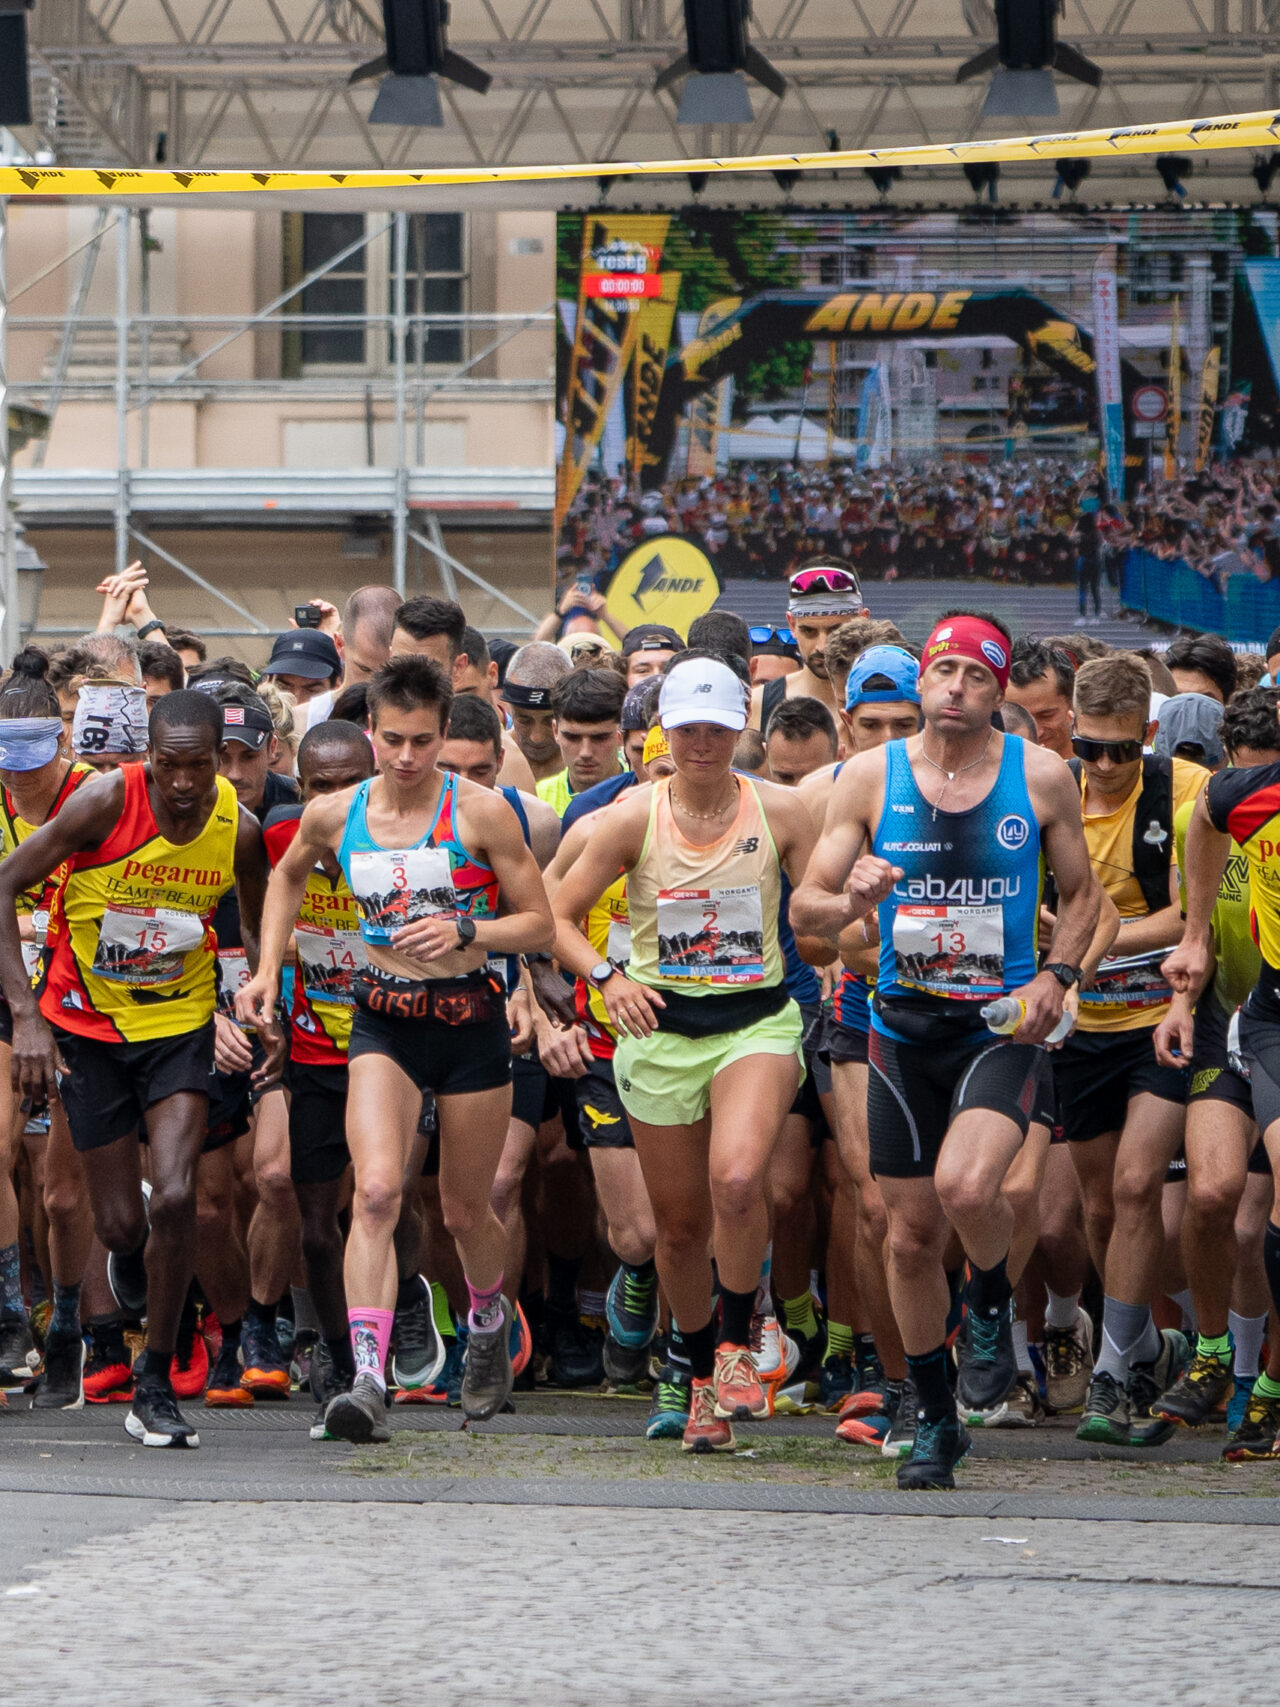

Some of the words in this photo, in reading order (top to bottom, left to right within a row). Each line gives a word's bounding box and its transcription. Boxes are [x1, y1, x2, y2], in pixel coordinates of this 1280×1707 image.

[1202, 121, 1240, 131] ANDE
[597, 255, 646, 274] reseg
[804, 290, 972, 332] ANDE
[652, 577, 706, 593] ANDE
[123, 858, 222, 888] pegarun
[392, 867, 408, 889] 3
[107, 875, 150, 898] TEAM
[702, 911, 718, 931] 2
[136, 930, 168, 951] 15
[930, 932, 967, 955] 13
[325, 950, 357, 969] 14
[124, 974, 158, 983] KEVIN
